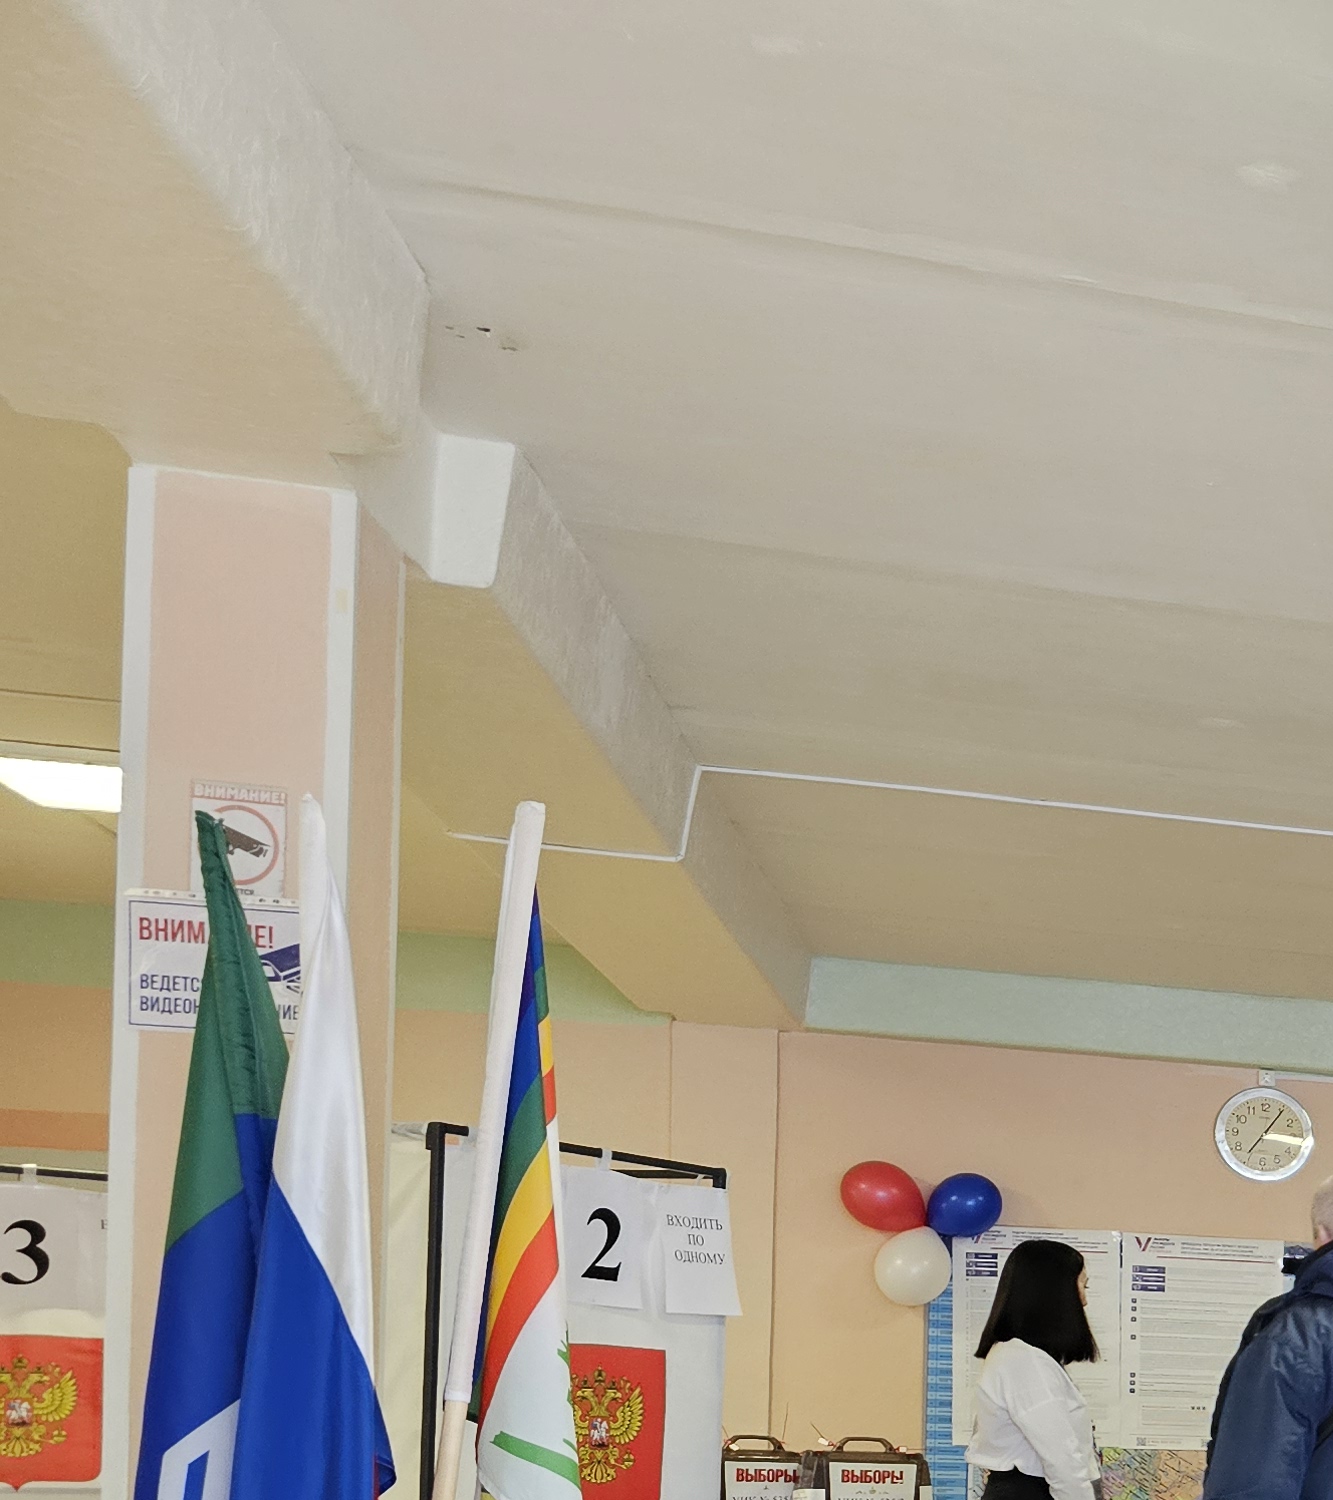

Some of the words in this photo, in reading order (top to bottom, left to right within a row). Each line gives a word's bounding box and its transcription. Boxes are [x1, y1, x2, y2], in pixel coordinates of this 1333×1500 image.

[194, 783, 286, 804] ВНИМАНИЕ!
[139, 917, 273, 949] ВНИМЕ!
[140, 974, 201, 993] ВЕДЕТС
[1247, 1105, 1256, 1116] 11
[1260, 1102, 1271, 1113] 12
[1235, 1114, 1247, 1125] 10
[1286, 1118, 1294, 1128] 2
[1231, 1127, 1239, 1137] 9
[1234, 1141, 1242, 1151] 8
[1284, 1146, 1292, 1155] 4
[1258, 1156, 1267, 1167] 6
[1273, 1154, 1281, 1165] 5
[666, 1214, 723, 1231] ВХОДИТЬ
[581, 1207, 622, 1282] 2
[688, 1233, 705, 1246] ПО
[0, 1219, 50, 1285] 3
[674, 1249, 726, 1265] ОДНОМУ
[841, 1469, 904, 1484] ВЫБОРЫ
